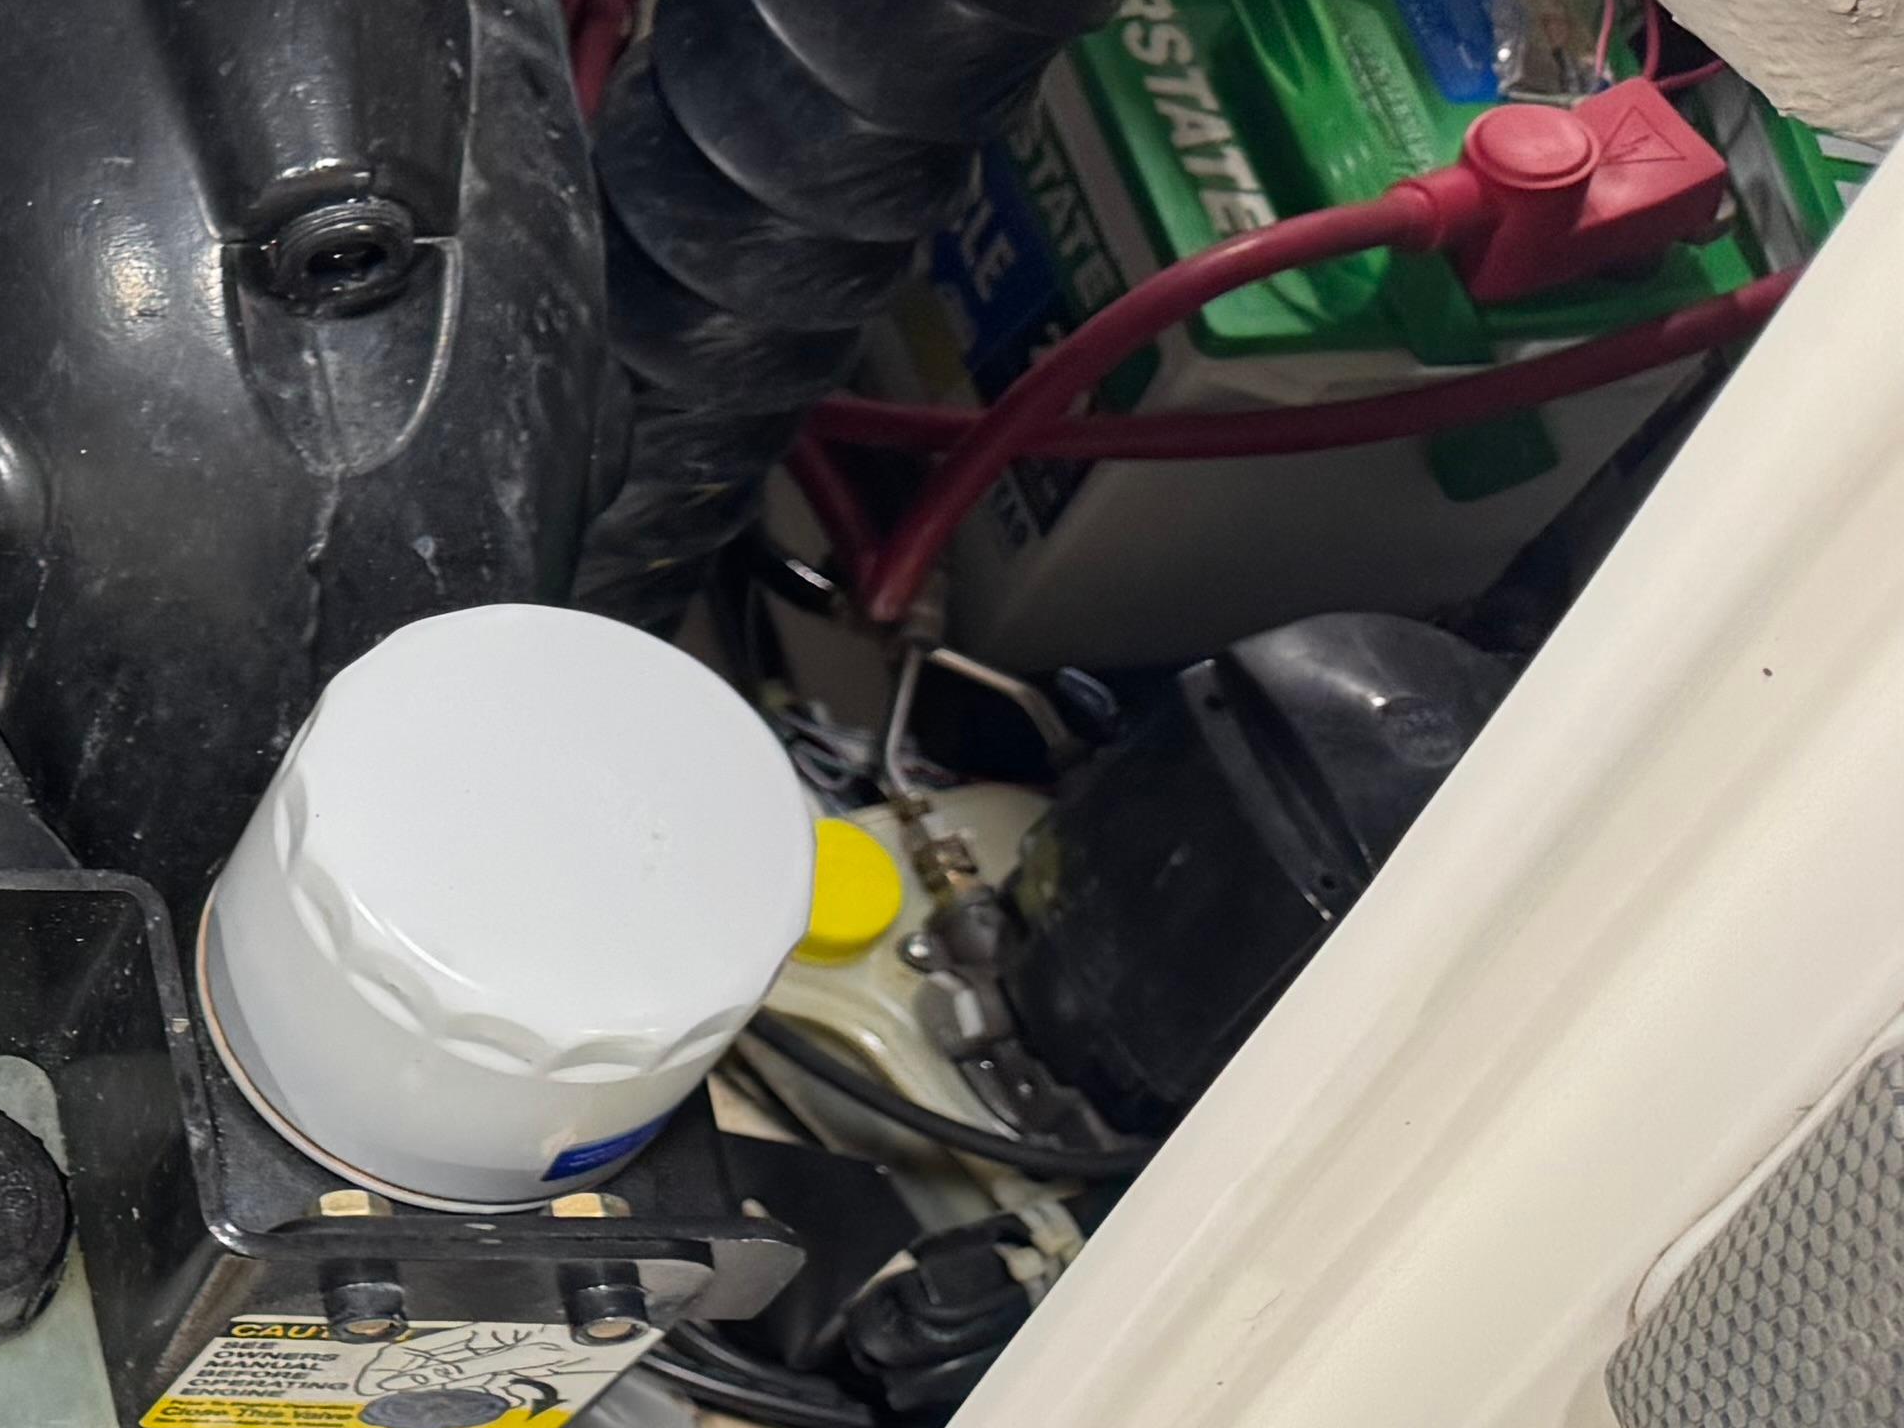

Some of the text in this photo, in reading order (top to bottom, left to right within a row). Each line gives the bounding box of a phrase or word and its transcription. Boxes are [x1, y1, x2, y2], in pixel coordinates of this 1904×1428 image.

[221, 1341, 279, 1349] SEE
[213, 1351, 340, 1362] OWNERS
[205, 1360, 324, 1371] MANUAL
[195, 1369, 313, 1379] BEFORE
[188, 1378, 349, 1390] OPERATING
[179, 1388, 287, 1397] ENGINE
[237, 1408, 285, 1419] This
